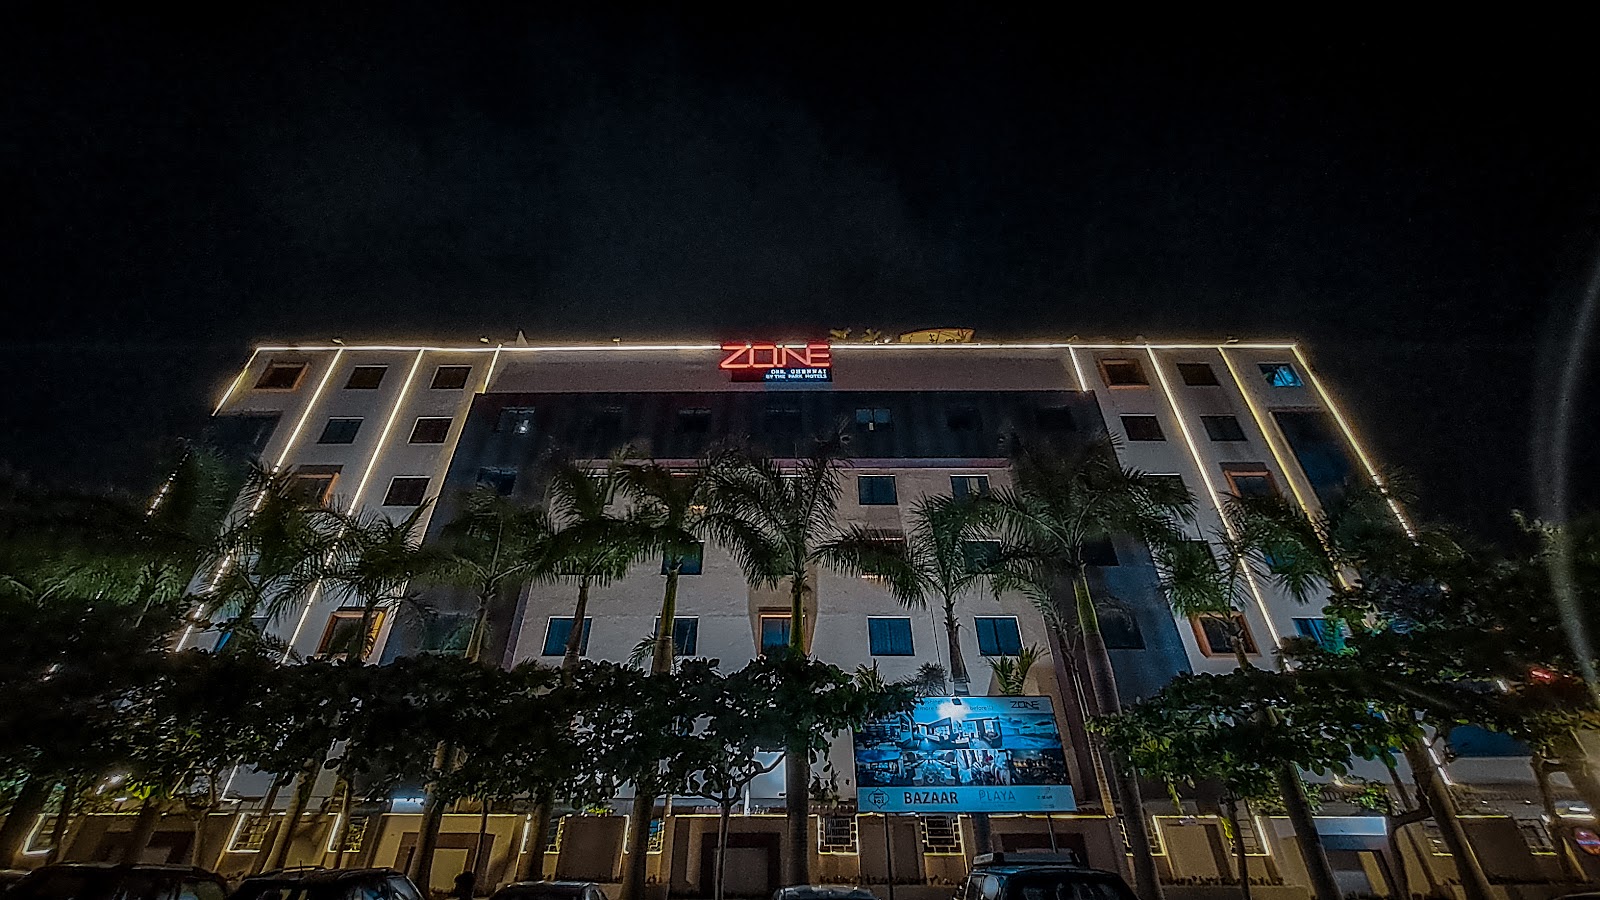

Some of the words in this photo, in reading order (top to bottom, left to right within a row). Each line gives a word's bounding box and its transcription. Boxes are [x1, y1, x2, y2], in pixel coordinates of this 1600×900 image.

[720, 344, 830, 368] ZONE
[1009, 700, 1040, 710] ZONE
[903, 791, 959, 805] BAZAAR
[978, 789, 1016, 801] PLAYA
